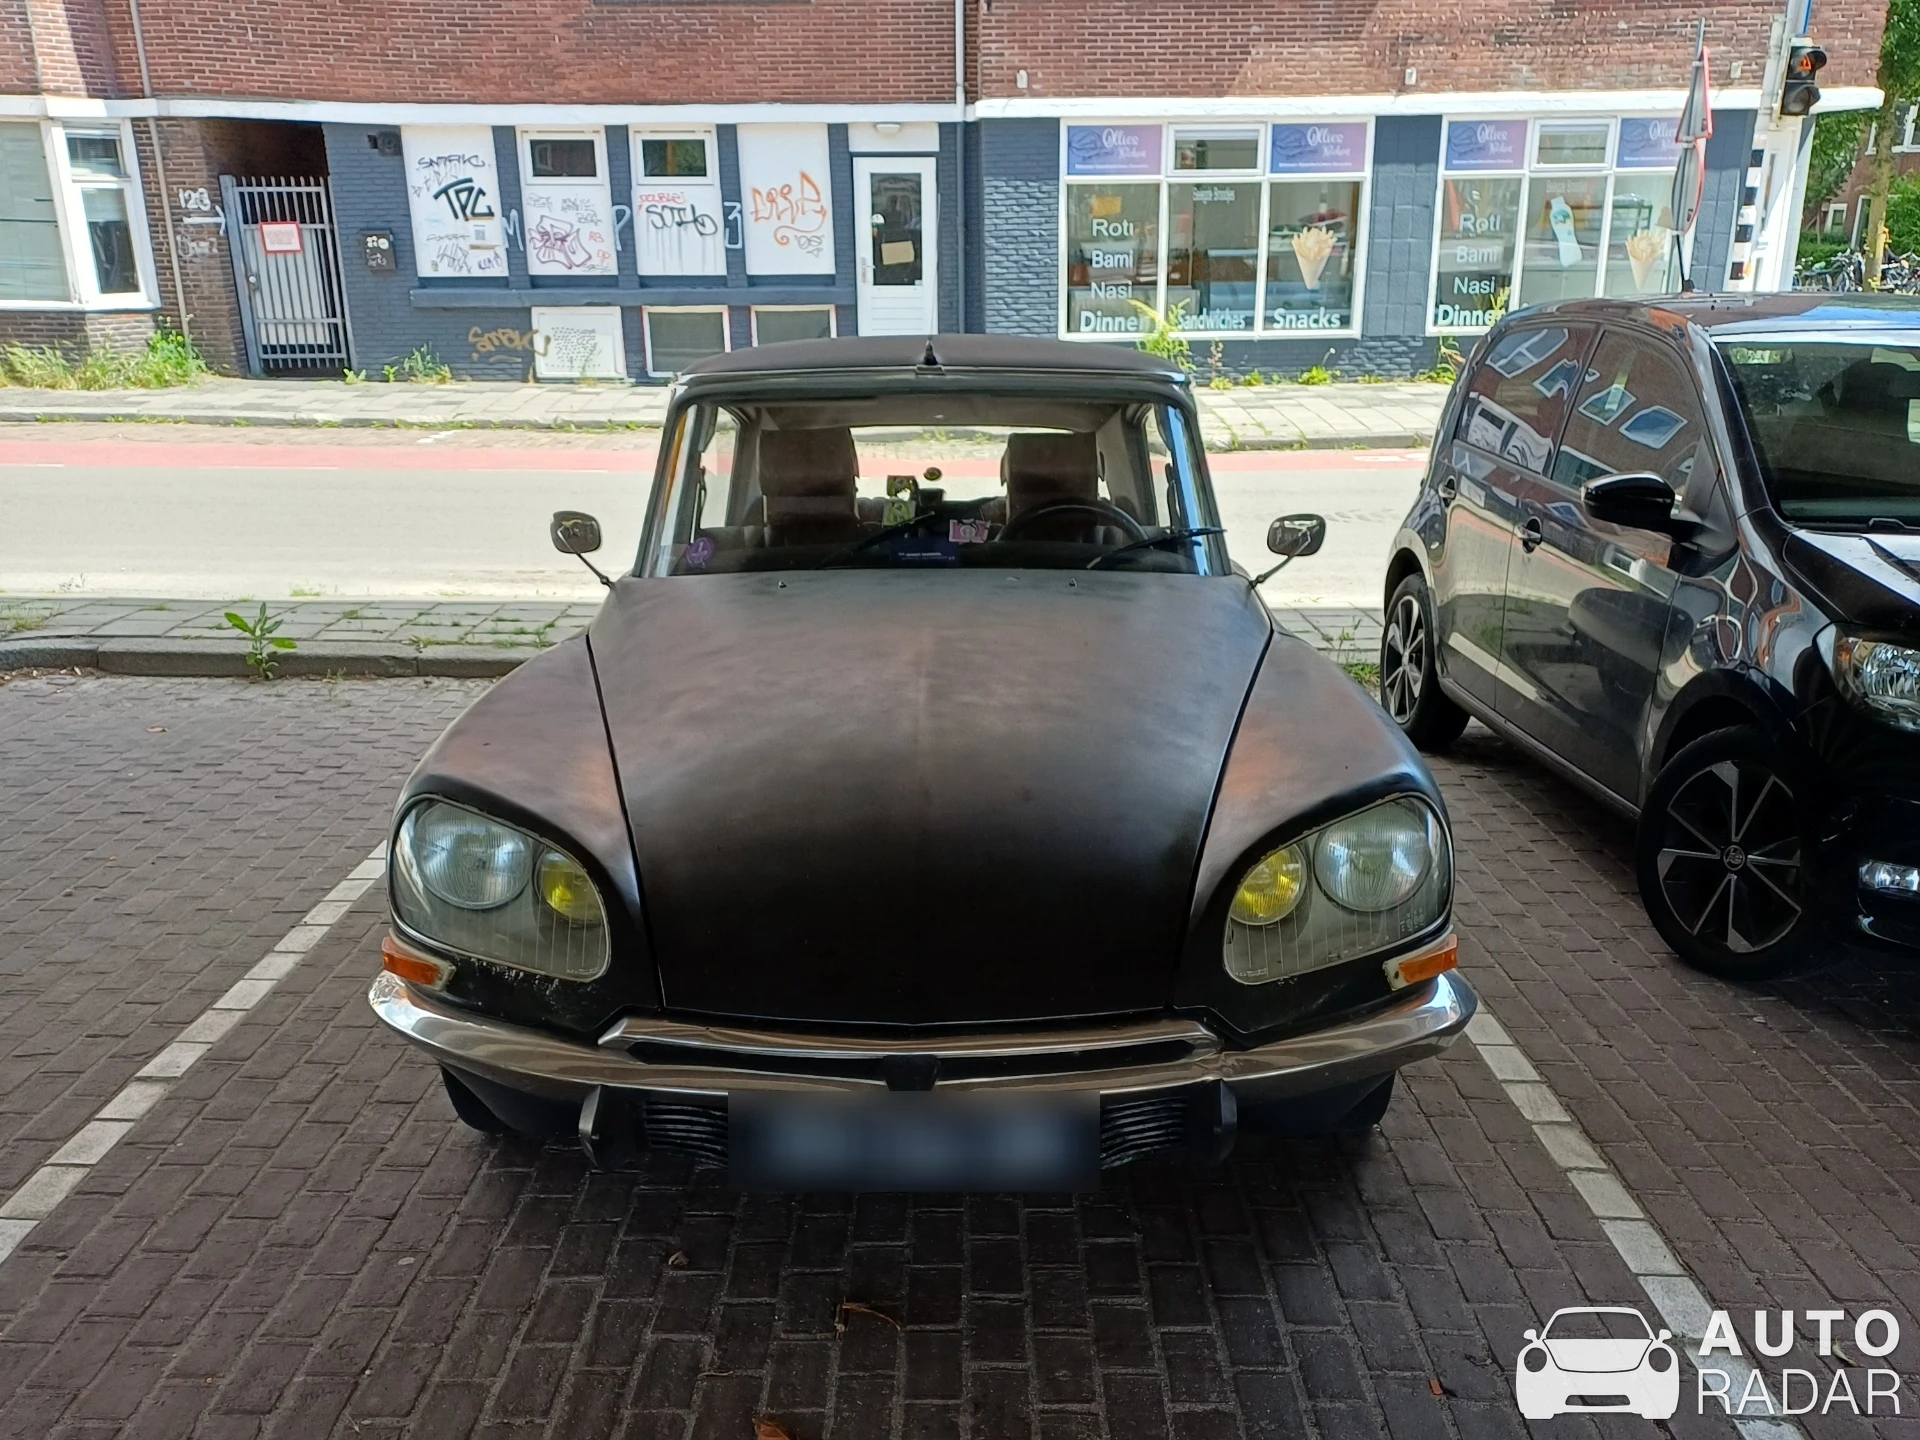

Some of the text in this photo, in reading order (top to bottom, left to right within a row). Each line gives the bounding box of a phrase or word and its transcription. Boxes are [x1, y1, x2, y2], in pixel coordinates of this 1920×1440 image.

[1092, 218, 1134, 237] Roti
[1459, 213, 1501, 232] Roti
[1091, 249, 1134, 269] Bami
[1456, 245, 1499, 264] Bami
[1090, 280, 1133, 300] Nasi
[1453, 275, 1496, 295] Nasi
[1177, 307, 1246, 330] Sandwiches
[1272, 306, 1342, 329] Snacks
